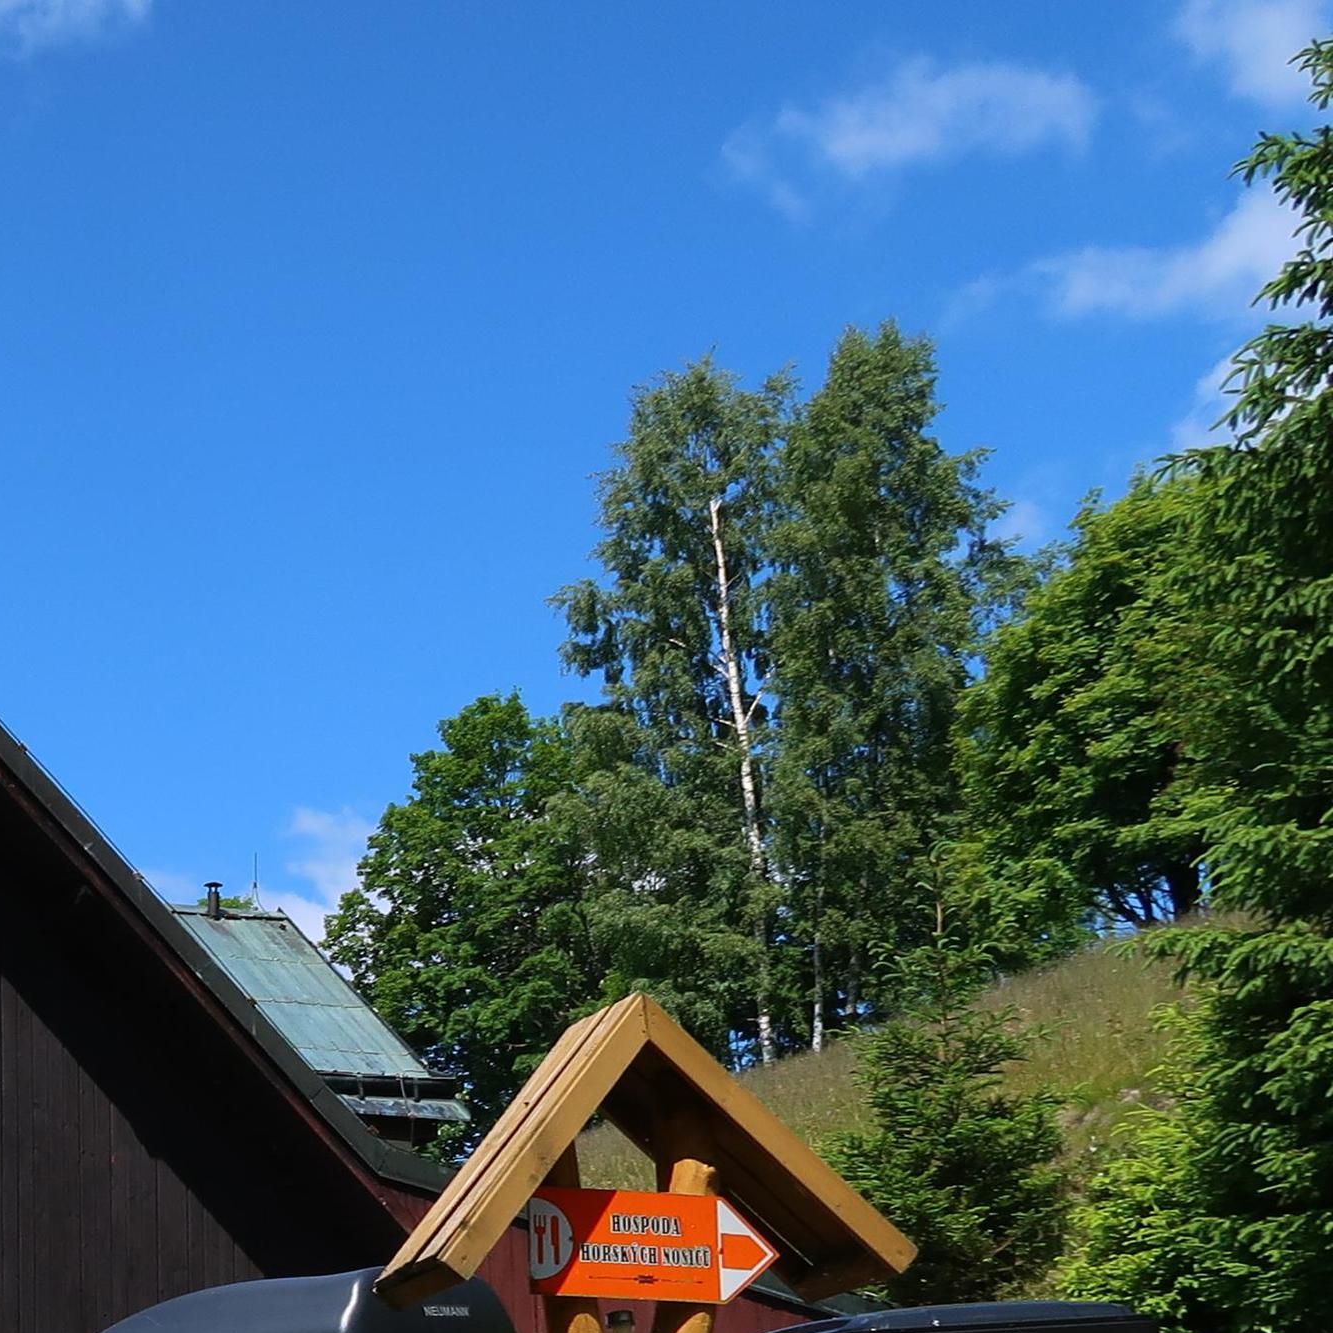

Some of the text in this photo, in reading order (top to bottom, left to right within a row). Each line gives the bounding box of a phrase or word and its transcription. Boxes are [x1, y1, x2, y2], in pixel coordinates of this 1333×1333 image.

[610, 1213, 682, 1237] HOSPODA
[579, 1241, 659, 1265] HORSKÝCH
[422, 1305, 470, 1317] NEUMANN
